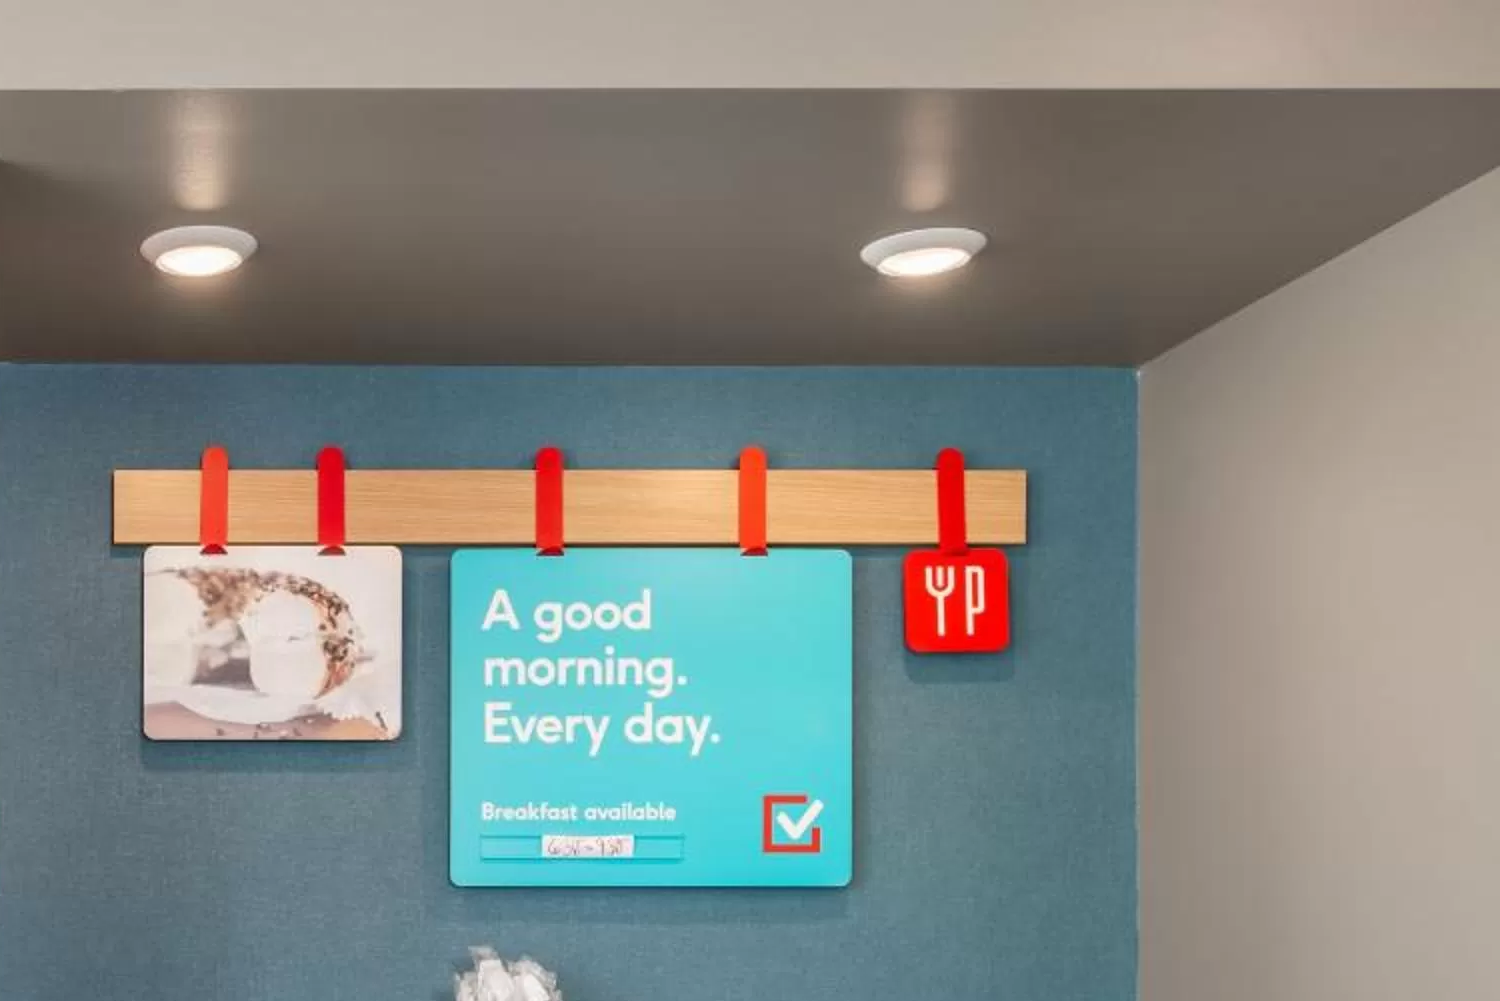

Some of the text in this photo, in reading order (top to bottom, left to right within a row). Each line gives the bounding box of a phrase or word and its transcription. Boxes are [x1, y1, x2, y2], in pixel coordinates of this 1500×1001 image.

[481, 588, 652, 643] A good
[484, 645, 688, 698] morning.
[484, 701, 721, 757] Every day.
[481, 802, 677, 821] Breakfast available
